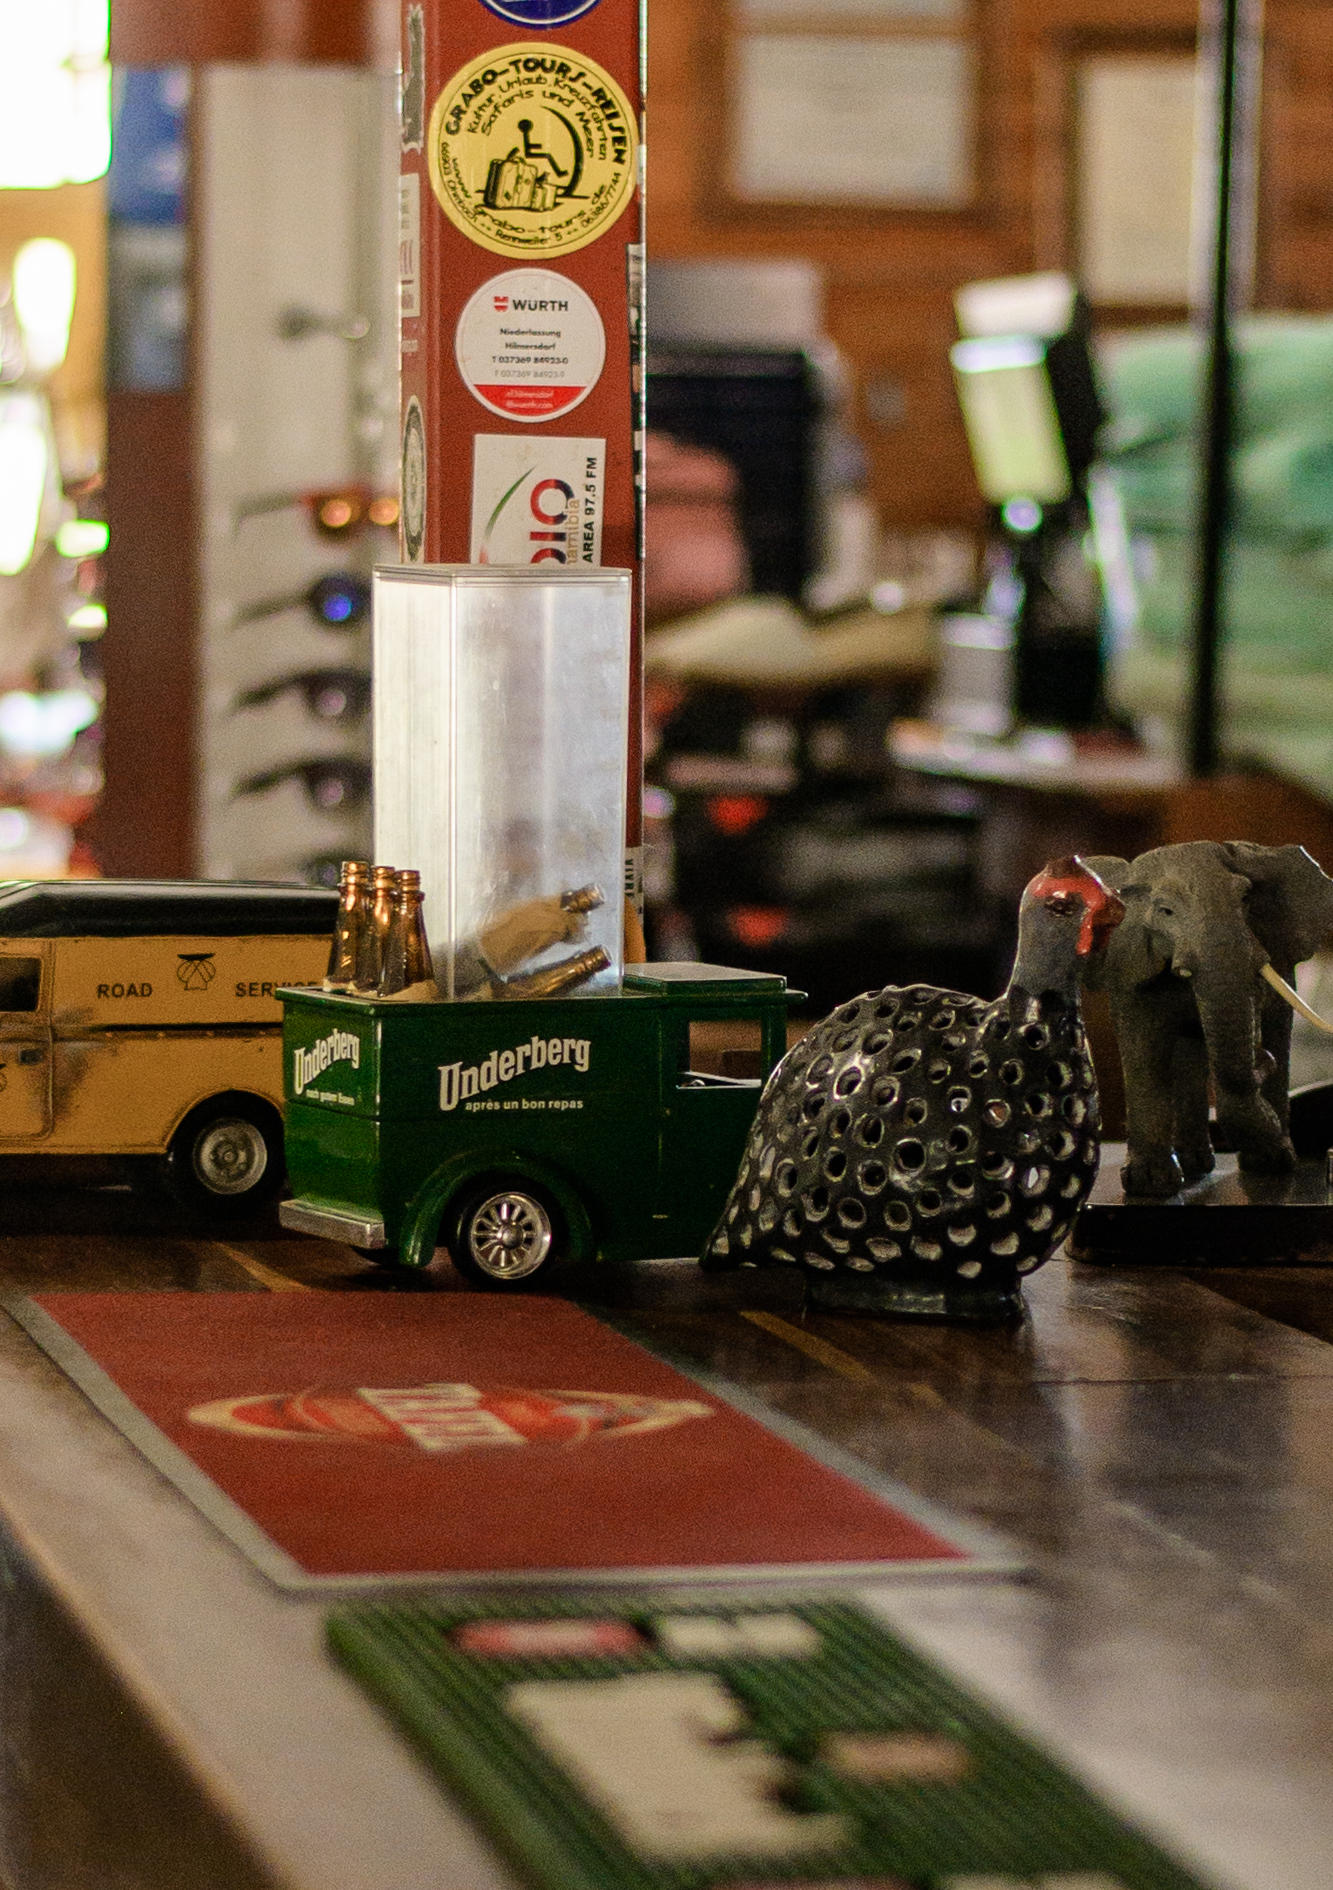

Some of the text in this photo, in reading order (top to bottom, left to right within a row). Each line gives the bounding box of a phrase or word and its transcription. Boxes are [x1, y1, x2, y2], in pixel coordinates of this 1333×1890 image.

[445, 57, 628, 166] GRABO-TOURS-REISEN
[481, 89, 595, 158] Safaris und Meer
[500, 327, 561, 338] Niederlassung
[512, 298, 569, 312] WÜRTH
[583, 457, 597, 564] AREA 97.5 FM
[97, 983, 153, 999] ROAD
[294, 1028, 361, 1095] Underberg
[438, 1035, 592, 1112] Underberg
[465, 1098, 584, 1112] après un bon repas
